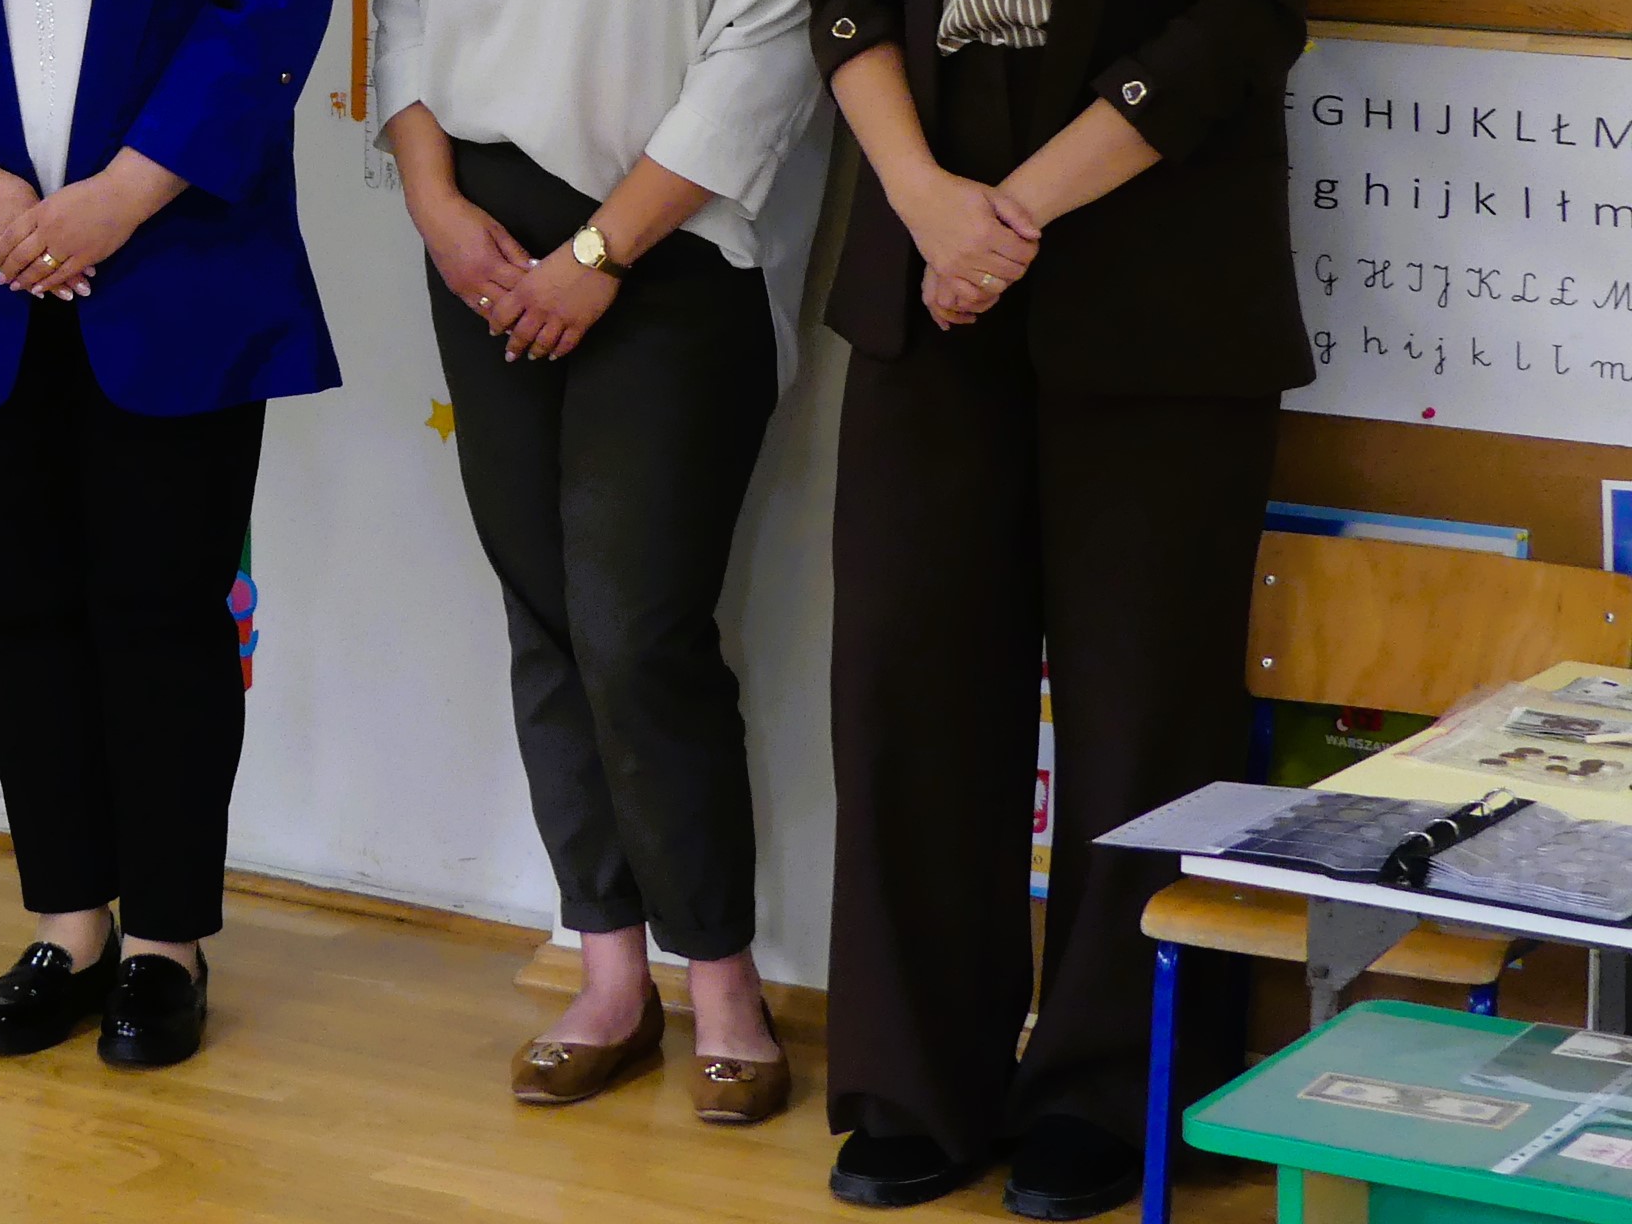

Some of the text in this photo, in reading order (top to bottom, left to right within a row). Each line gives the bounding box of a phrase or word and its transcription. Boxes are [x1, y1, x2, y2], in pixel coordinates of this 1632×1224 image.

[1312, 95, 1344, 126] G
[1364, 98, 1392, 129] H
[1413, 102, 1420, 132] I
[1436, 105, 1451, 135] J
[1473, 107, 1497, 139] K
[1516, 110, 1536, 142] L
[1551, 114, 1576, 146] Ł
[1313, 178, 1339, 210] g
[1364, 173, 1389, 207] h
[1414, 178, 1420, 209] i
[1437, 181, 1451, 219] j
[1475, 182, 1497, 216] k
[1556, 190, 1570, 222] ł
[1315, 254, 1339, 295] G
[1357, 258, 1394, 289] H
[1433, 265, 1451, 308] J
[1466, 268, 1501, 300] K
[1511, 273, 1539, 303] L
[1550, 277, 1578, 306] Ł
[1314, 331, 1336, 364] g
[1364, 326, 1388, 355] h
[1404, 333, 1423, 359] i
[1435, 337, 1447, 375] j
[1473, 337, 1492, 367] k
